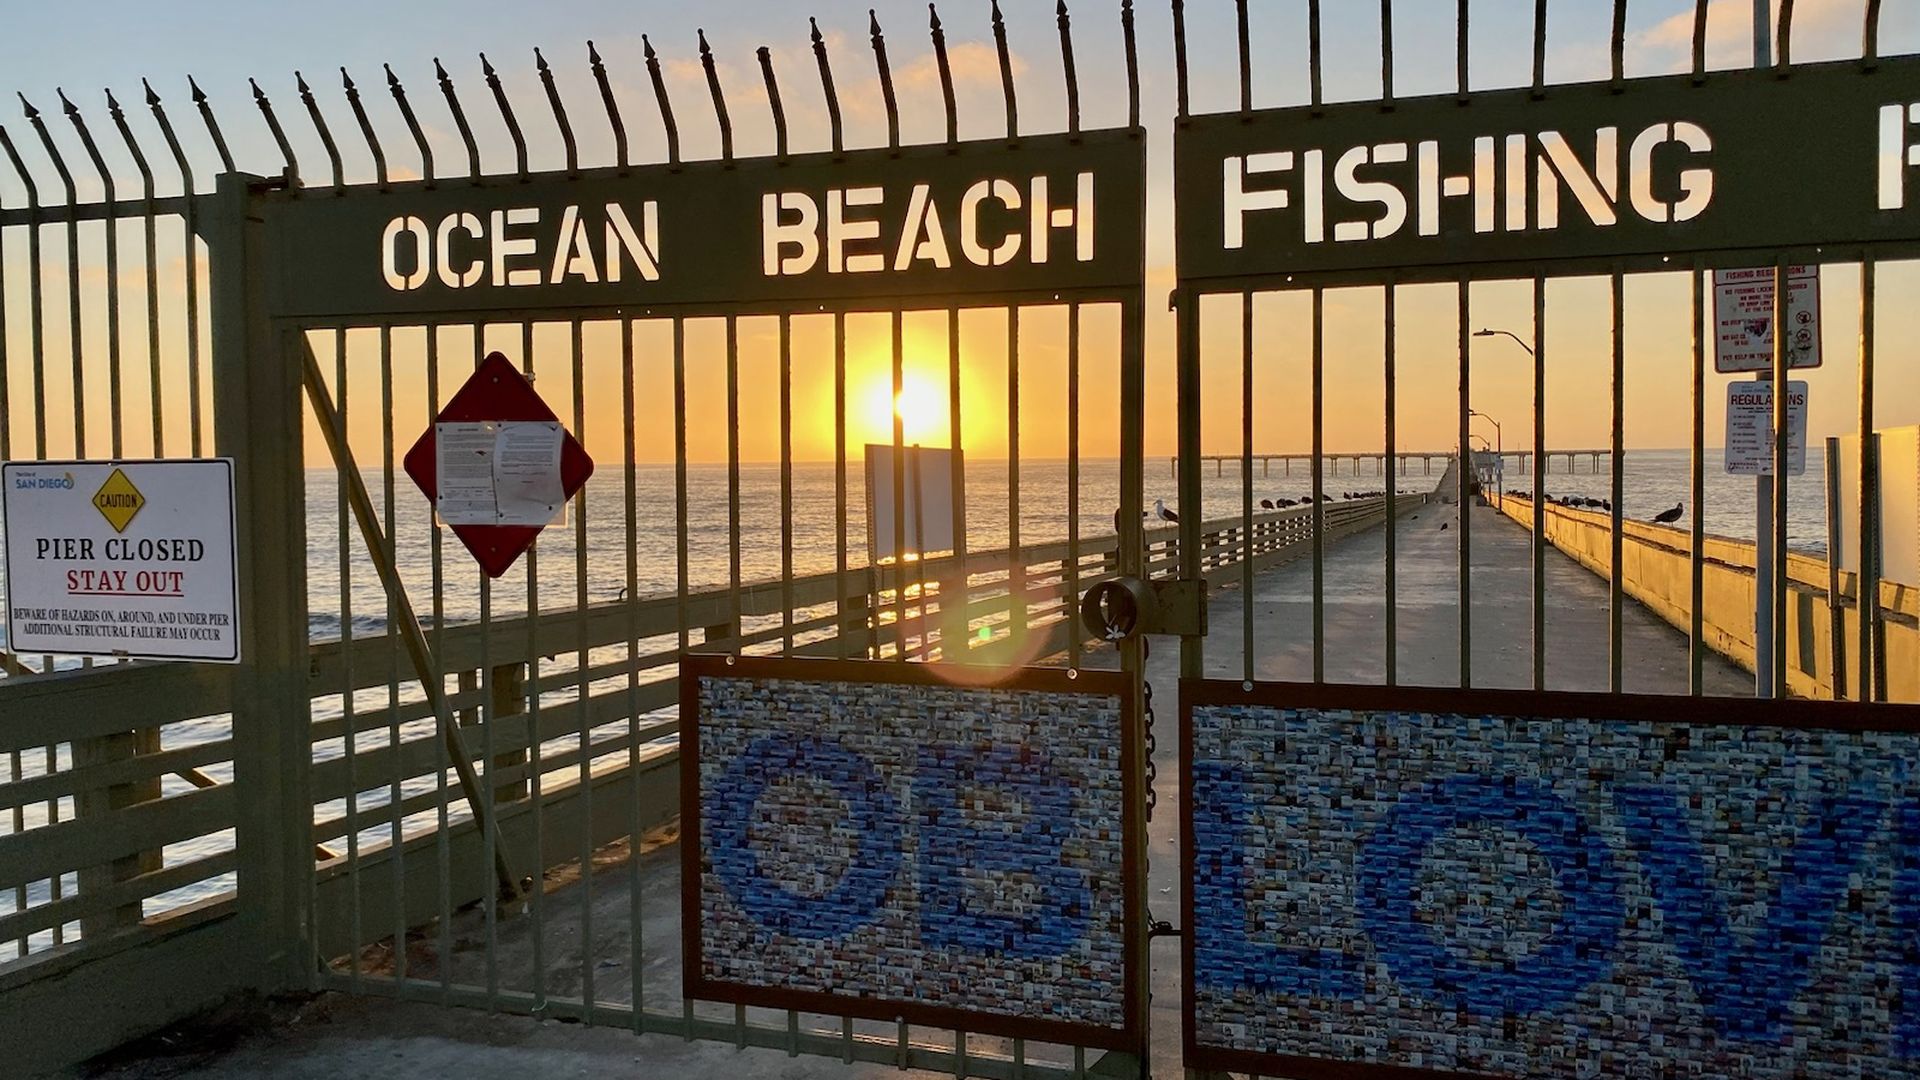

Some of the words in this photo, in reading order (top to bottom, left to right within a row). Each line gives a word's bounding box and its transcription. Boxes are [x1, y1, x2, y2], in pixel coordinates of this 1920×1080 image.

[1223, 122, 1713, 249] FISHING
[382, 201, 660, 290] OCEAN
[762, 172, 1094, 275] BEACH
[16, 479, 36, 489] SAN
[38, 479, 70, 489] DIEGO
[100, 494, 138, 508] CAUTION
[36, 538, 95, 560] PIER
[105, 538, 204, 562] CLOSED
[67, 570, 127, 591] STAY
[136, 571, 184, 592] OUT
[13, 608, 47, 620] BEWARE
[48, 609, 60, 620] OF
[60, 609, 100, 621] HAZARDS
[101, 610, 116, 623] ON,
[118, 610, 156, 624] AROUND,
[158, 612, 176, 624] AND
[176, 612, 208, 625] UNDER
[209, 613, 229, 626] PIER
[23, 623, 73, 636] ADDITIONAL
[75, 624, 130, 637] STRUCTURAL
[131, 625, 168, 639] FAILURE
[169, 627, 189, 640] MAY
[189, 628, 221, 641] OCCUR
[711, 734, 1093, 958] OB
